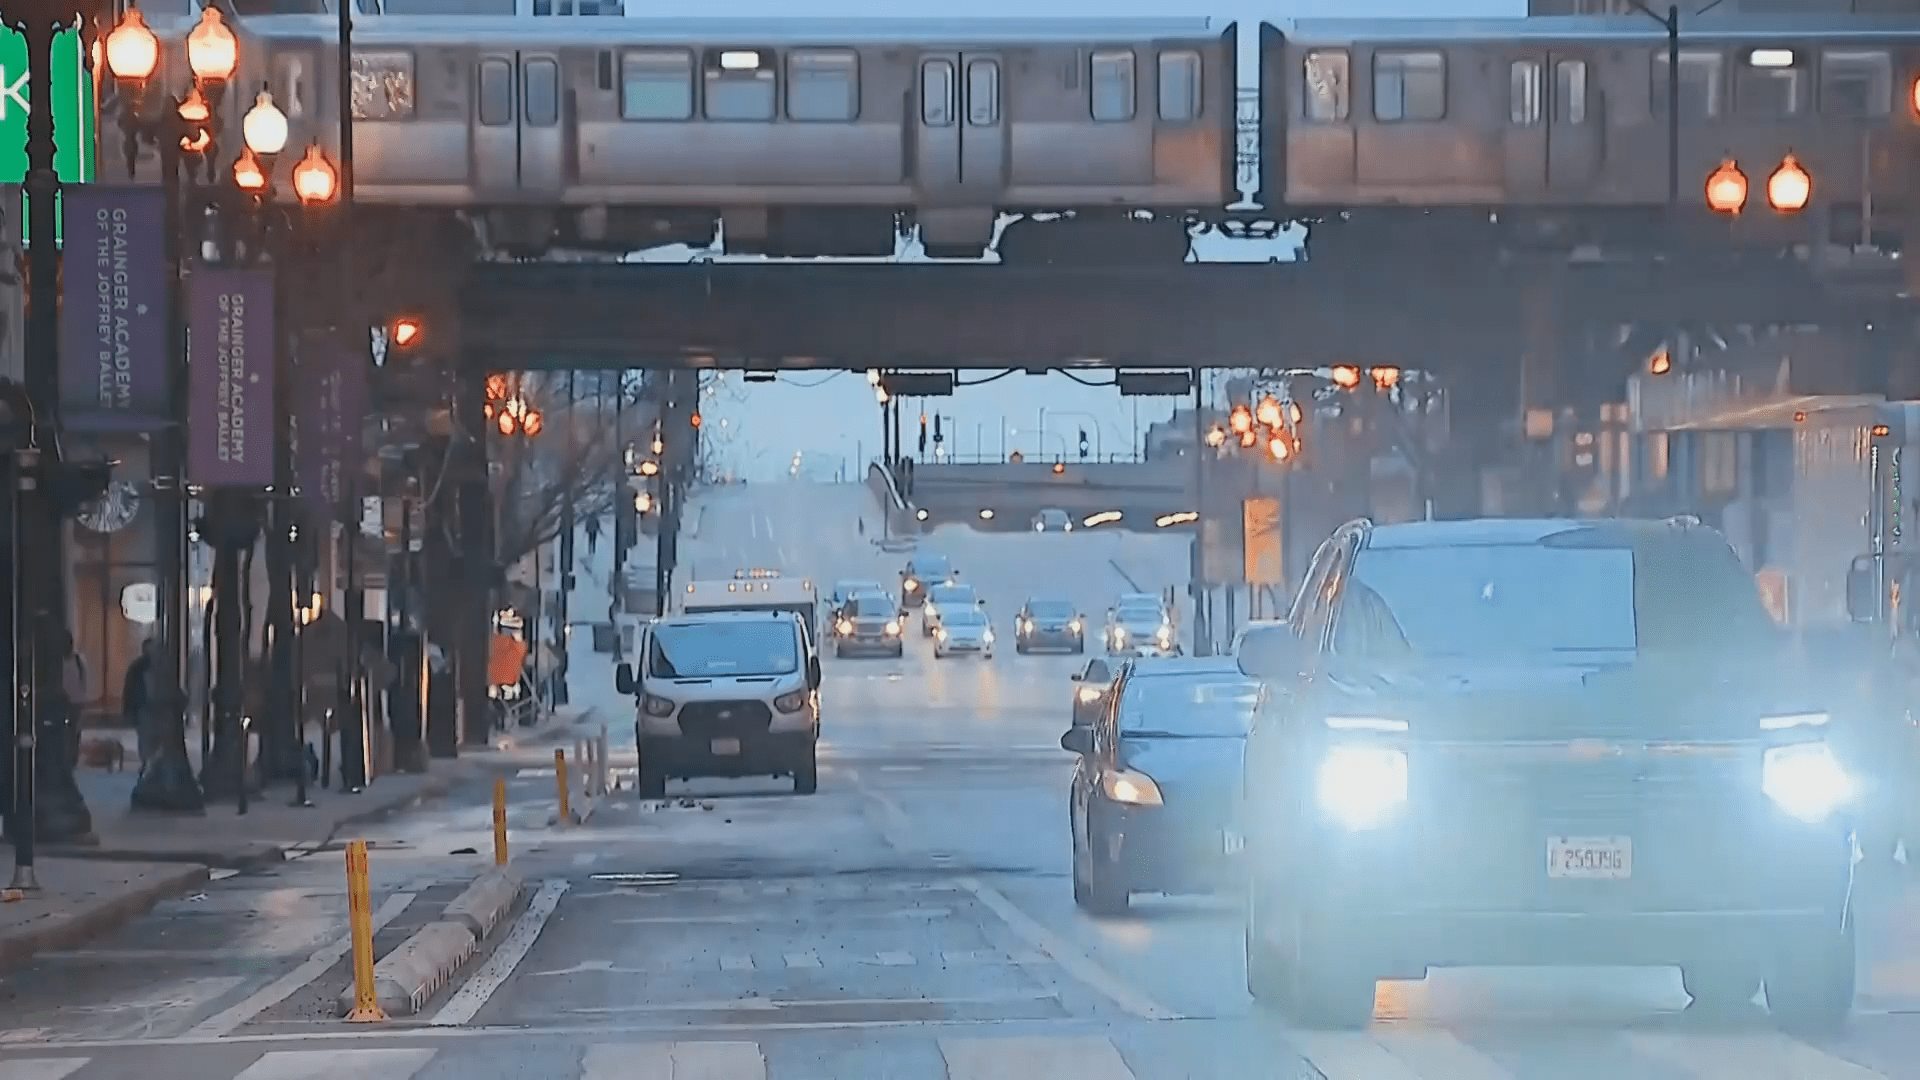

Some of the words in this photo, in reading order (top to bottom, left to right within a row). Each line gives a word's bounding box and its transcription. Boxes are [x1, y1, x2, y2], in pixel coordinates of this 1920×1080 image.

[96, 208, 109, 231] OF
[97, 236, 109, 268] THE
[112, 207, 129, 311] GRAINGER
[97, 272, 111, 346] JOFFREY
[217, 317, 229, 343] THE
[218, 293, 229, 313] OF
[114, 315, 131, 409] ACADEMY
[231, 293, 245, 379] GRAINGER
[217, 345, 230, 408] JOFFREY
[217, 411, 230, 463] BALLET
[231, 383, 245, 463] ACADEMY
